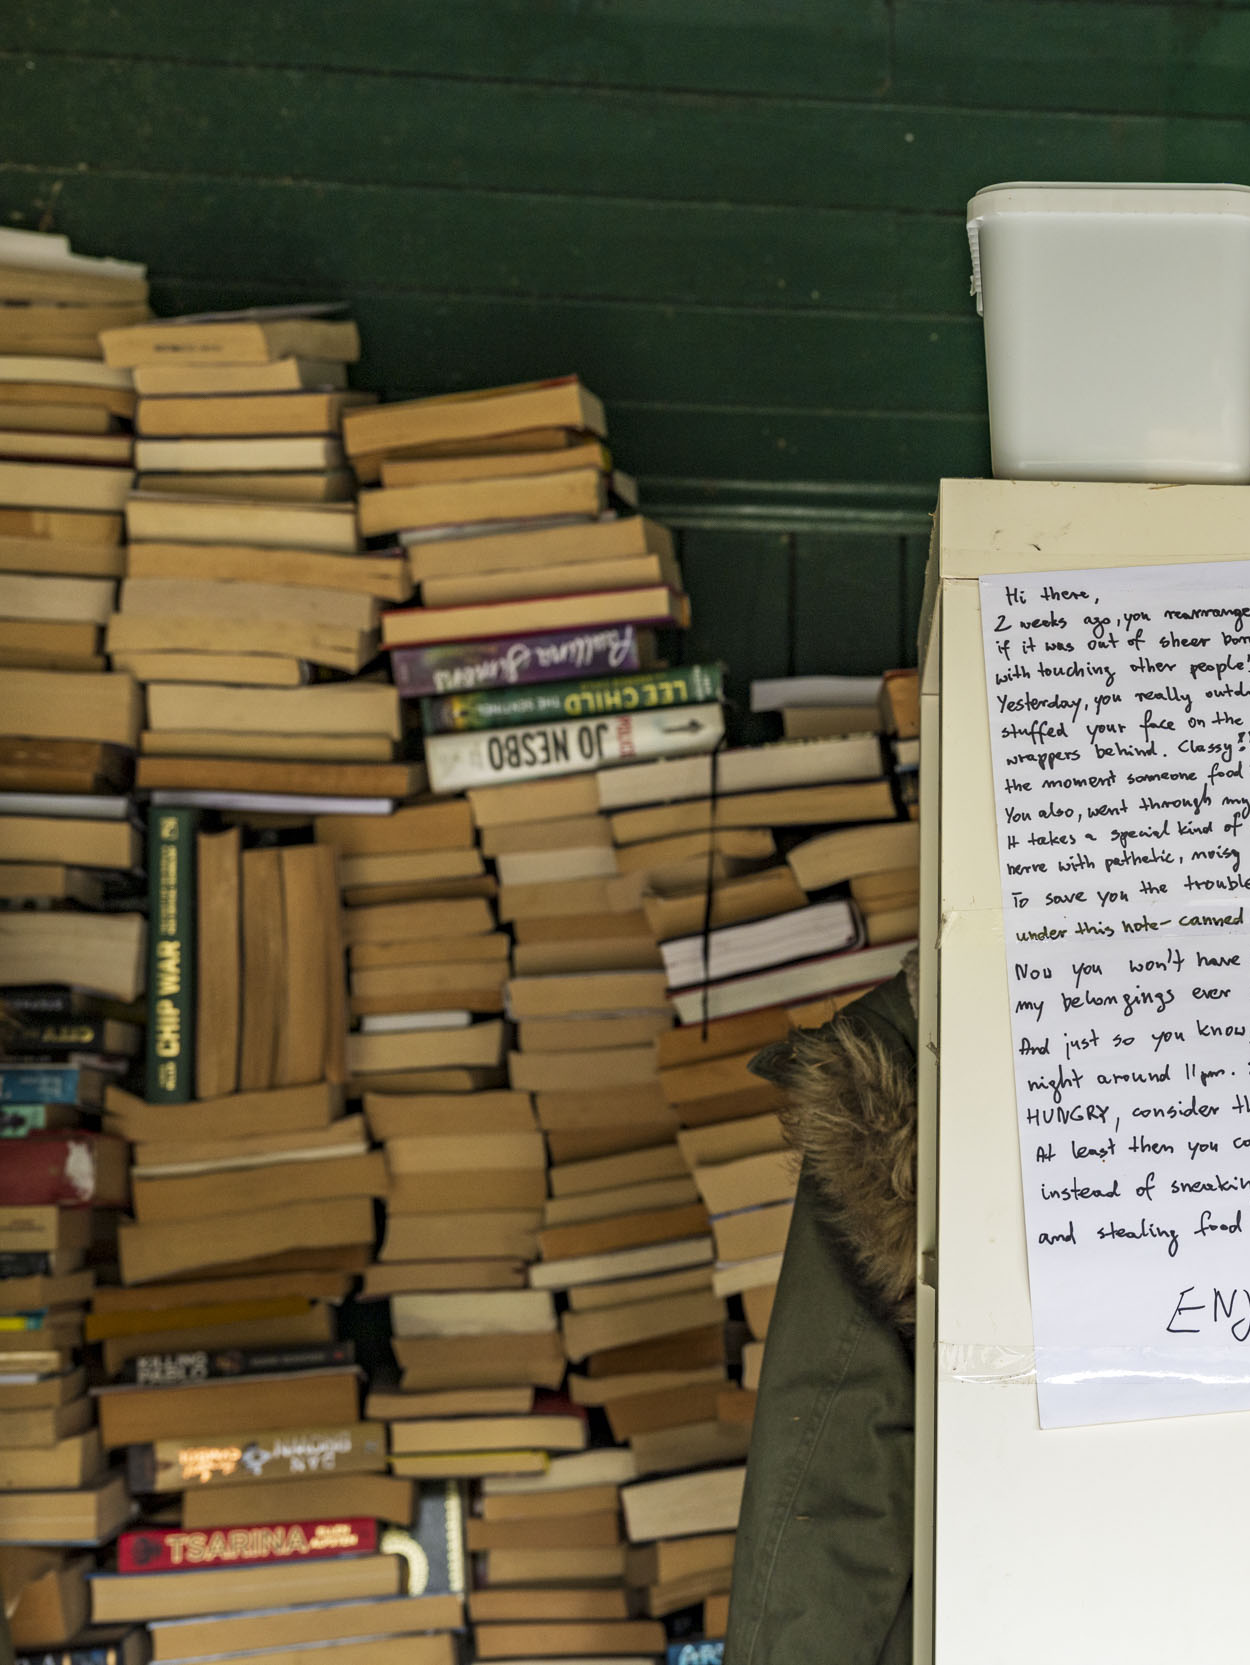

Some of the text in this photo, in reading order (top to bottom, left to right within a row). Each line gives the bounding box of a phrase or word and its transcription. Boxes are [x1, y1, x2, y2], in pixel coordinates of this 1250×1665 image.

[1004, 585, 1100, 607] Hi there,
[1019, 610, 1068, 630] weeks
[1021, 636, 1037, 655] it
[1044, 641, 1076, 653] was
[1086, 631, 1120, 651] out
[1158, 630, 1212, 649] sheer
[995, 663, 1031, 686] with
[1036, 660, 1117, 688] touching
[1129, 656, 1177, 674] other
[566, 685, 640, 715] CHILD
[641, 678, 688, 703] LEE
[996, 691, 1089, 725] Yesterday,
[1093, 693, 1123, 716] you
[1134, 685, 1193, 715] really
[1001, 719, 1069, 746] stuffed
[1085, 723, 1127, 746] your
[1138, 708, 1177, 744] face
[488, 722, 609, 771] JO NESBO
[1005, 749, 1081, 771] wrappers
[1093, 739, 1168, 760] behind.
[1004, 778, 1033, 795] the
[1041, 769, 1117, 790] moment
[1126, 771, 1198, 785] someone
[1206, 759, 1244, 787] food
[1004, 806, 1033, 825] You
[1038, 801, 1083, 823] also,
[1087, 798, 1129, 819] went
[1138, 782, 1212, 816] through
[1026, 830, 1077, 847] takes
[1110, 819, 1171, 849] special
[1176, 820, 1214, 836] kind
[1006, 862, 1048, 876] nerve
[1057, 852, 1096, 873] with
[1104, 846, 1184, 873] pathetic,
[1045, 891, 1088, 907] save
[1138, 879, 1169, 895] the
[1015, 925, 1068, 943] under
[1074, 920, 1116, 938] this
[1178, 906, 1244, 928] canned
[156, 941, 181, 996] WAR
[1071, 962, 1103, 990] you
[1128, 947, 1186, 973] won't
[1195, 951, 1241, 968] have
[1060, 984, 1176, 1018] belongings
[1191, 986, 1232, 1000] ever
[155, 1000, 180, 1058] CHIP
[1063, 1028, 1100, 1061] just
[1151, 1030, 1186, 1053] you
[1027, 1063, 1084, 1105] night
[1096, 1063, 1171, 1085] around
[1026, 1104, 1120, 1134] HUNGRY,
[1131, 1094, 1220, 1120] consider
[1072, 1137, 1117, 1159] least
[1127, 1134, 1175, 1155] then
[1187, 1140, 1219, 1161] you
[1040, 1176, 1122, 1202] instead
[1038, 1220, 1077, 1246] and
[1096, 1217, 1180, 1258] stealing
[1193, 1209, 1243, 1237] food
[164, 1527, 309, 1565] TSARINA
